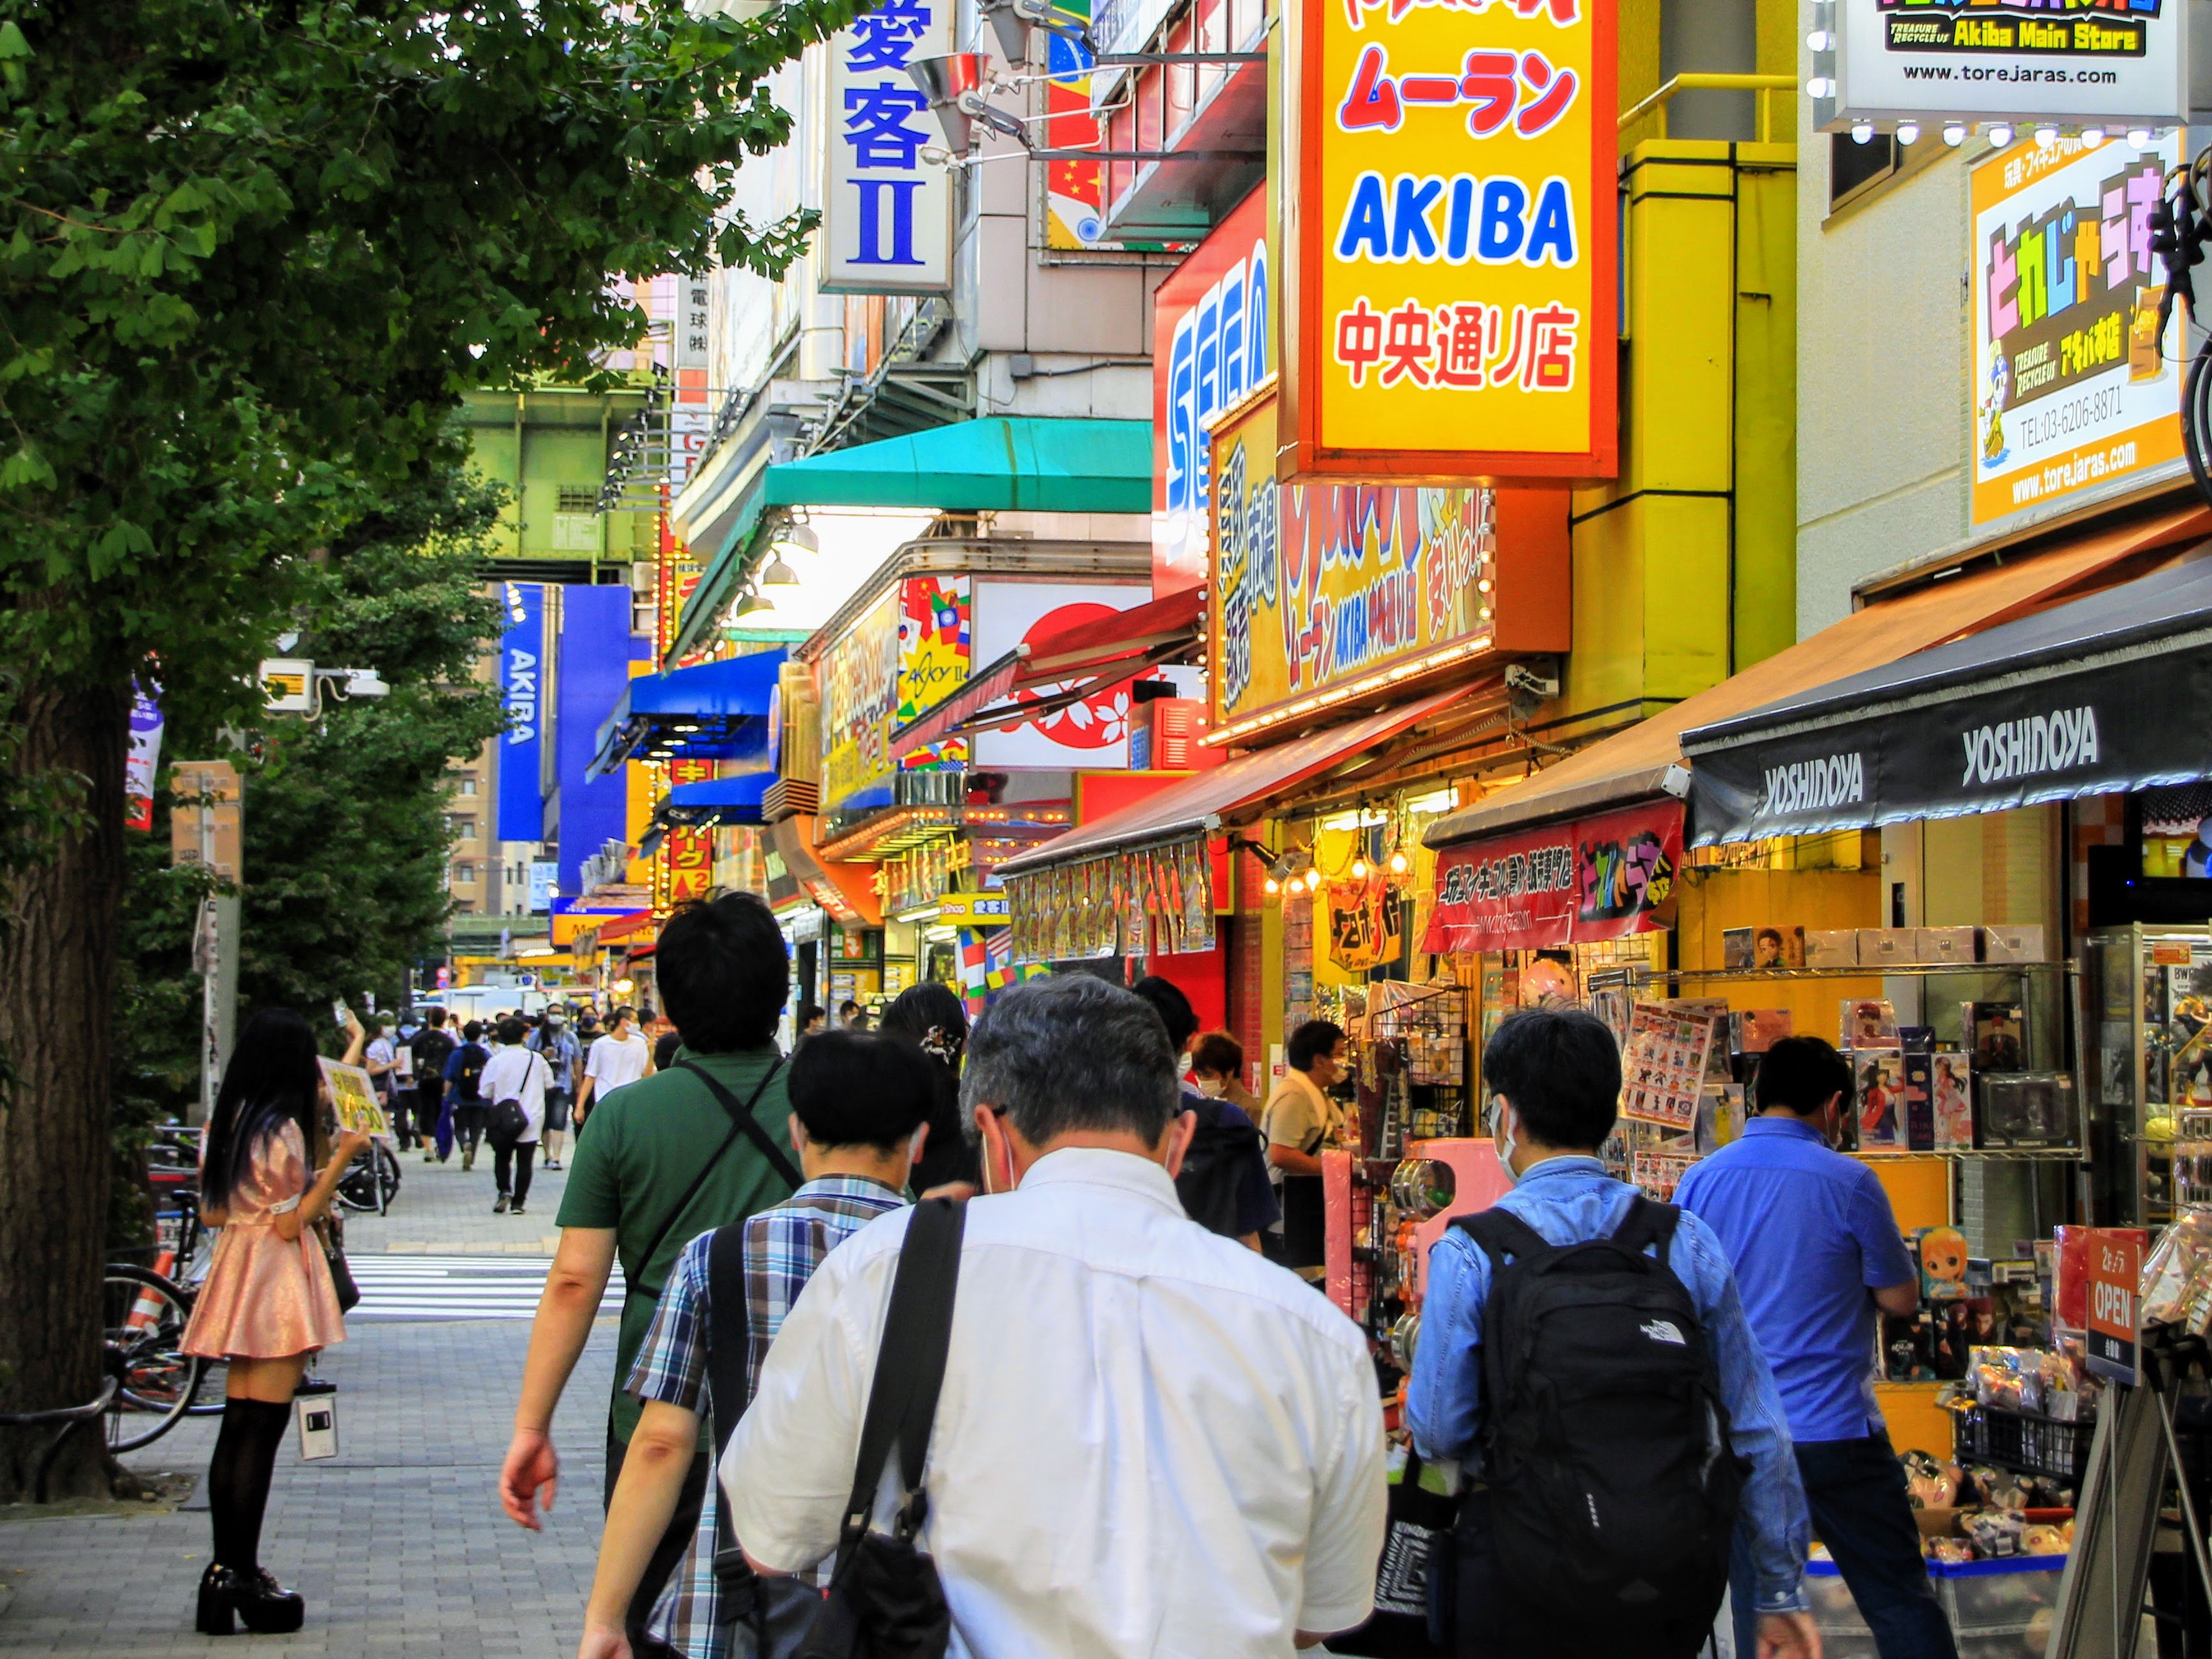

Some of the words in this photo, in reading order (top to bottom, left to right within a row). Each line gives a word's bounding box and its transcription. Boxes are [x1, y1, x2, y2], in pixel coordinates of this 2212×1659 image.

[1890, 22, 1939, 35] TREASURE
[1953, 20, 2012, 47] Akiba
[2019, 22, 2067, 49] Main
[2074, 23, 2137, 51] Store
[1340, 45, 1577, 136] ムーラン
[1903, 64, 2117, 84] www.torejaras.com
[1337, 173, 1576, 264] AKIBA
[1337, 298, 1577, 389] 中央通り店
[2014, 342, 2049, 378] TREASURE
[2020, 385, 2122, 449] TEL:03-6206-8871
[2012, 441, 2136, 505] www.torejaras.com
[509, 647, 536, 746] AKIBA
[1962, 705, 2097, 787] YOSHINOYA
[1761, 751, 1863, 817] YOSHINOYA
[2095, 1280, 2130, 1329] OPEN
